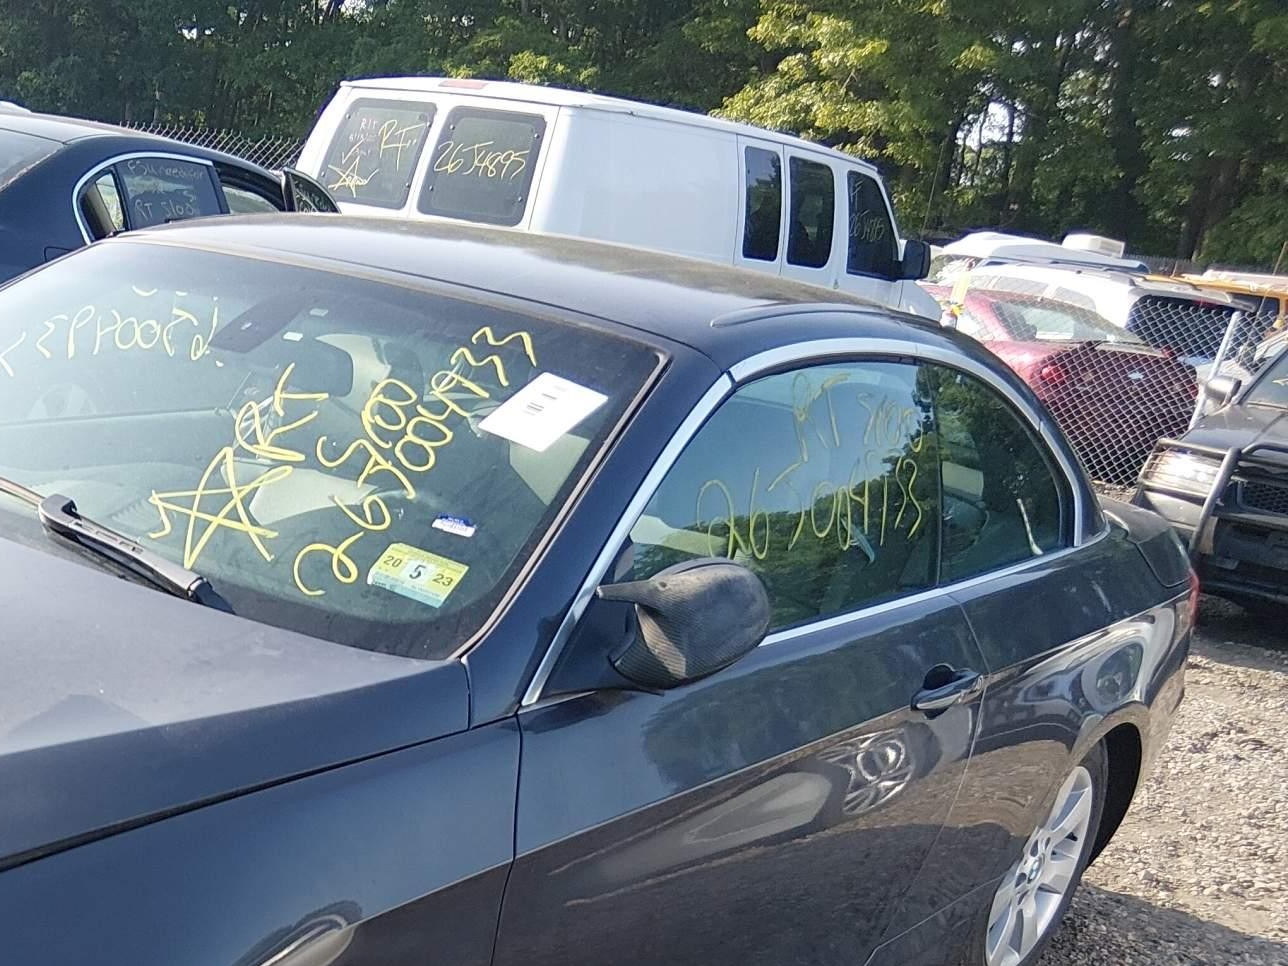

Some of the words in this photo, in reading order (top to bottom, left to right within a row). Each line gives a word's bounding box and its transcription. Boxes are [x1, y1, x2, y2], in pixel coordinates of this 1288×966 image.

[383, 555, 402, 568] 20
[409, 564, 426, 580] 5
[432, 573, 453, 587] 23
